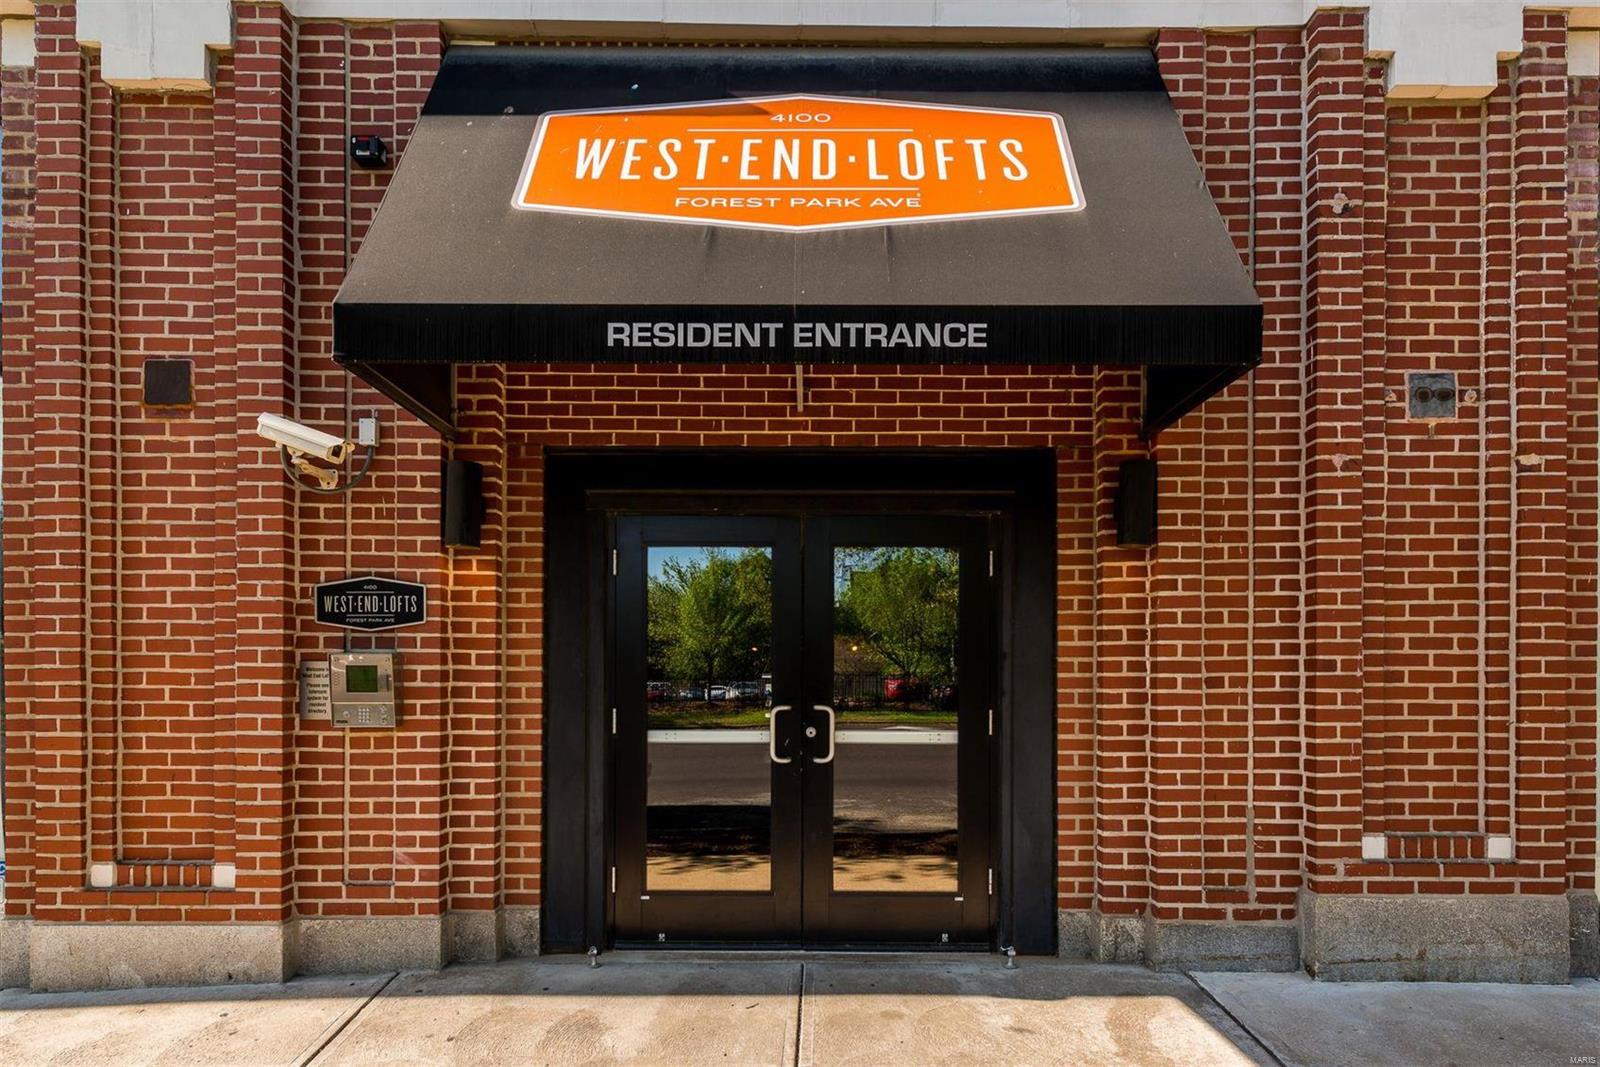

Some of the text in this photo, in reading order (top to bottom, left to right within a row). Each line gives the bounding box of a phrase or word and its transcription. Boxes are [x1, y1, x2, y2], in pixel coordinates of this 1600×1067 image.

[770, 112, 832, 123] 4100
[674, 195, 922, 208] FOREST PARK AVE
[606, 322, 989, 347] RESIDENT ENTRANCE
